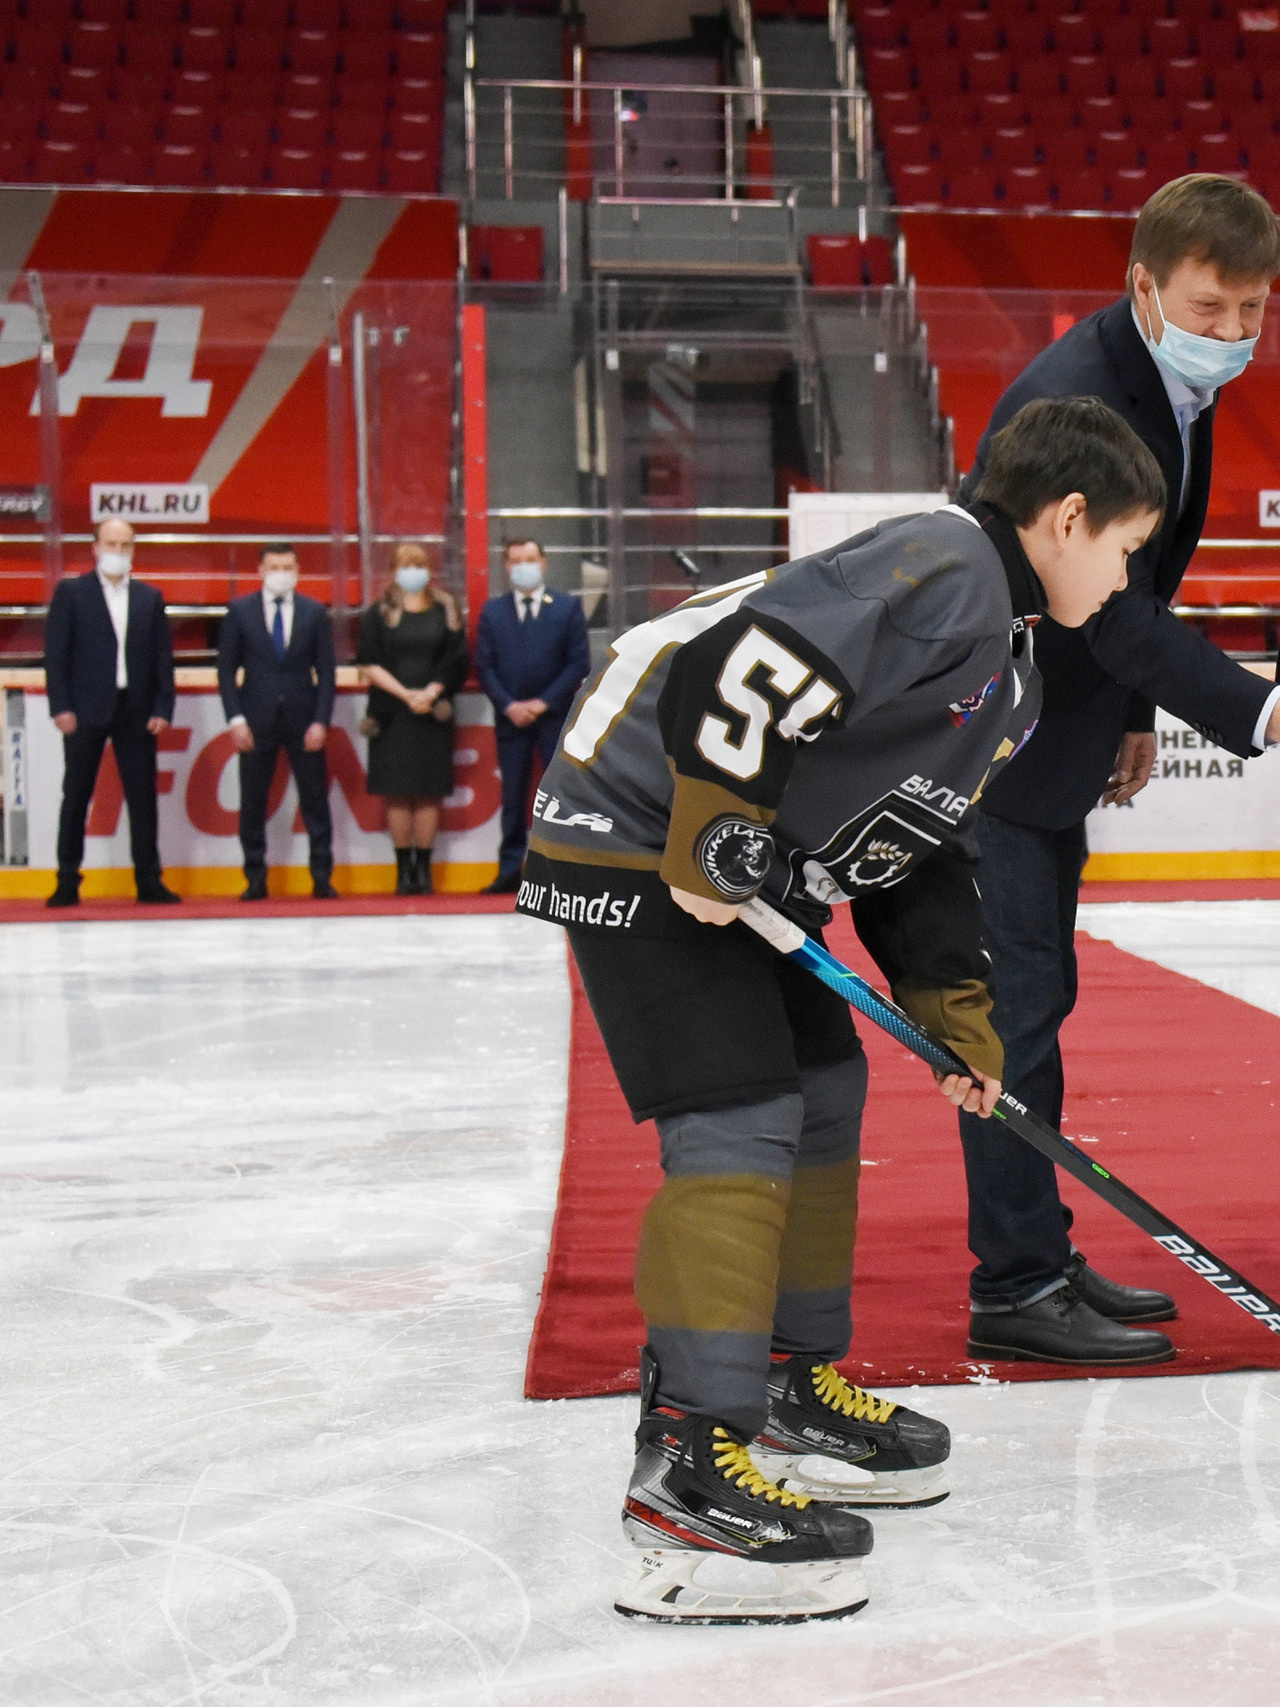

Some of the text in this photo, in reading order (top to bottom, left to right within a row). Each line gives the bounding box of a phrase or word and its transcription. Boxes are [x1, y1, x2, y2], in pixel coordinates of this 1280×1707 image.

[98, 494, 200, 514] KHL.RU
[515, 880, 641, 929] our hands!
[802, 1426, 846, 1447] BAUER
[706, 1506, 754, 1530] BAUER
